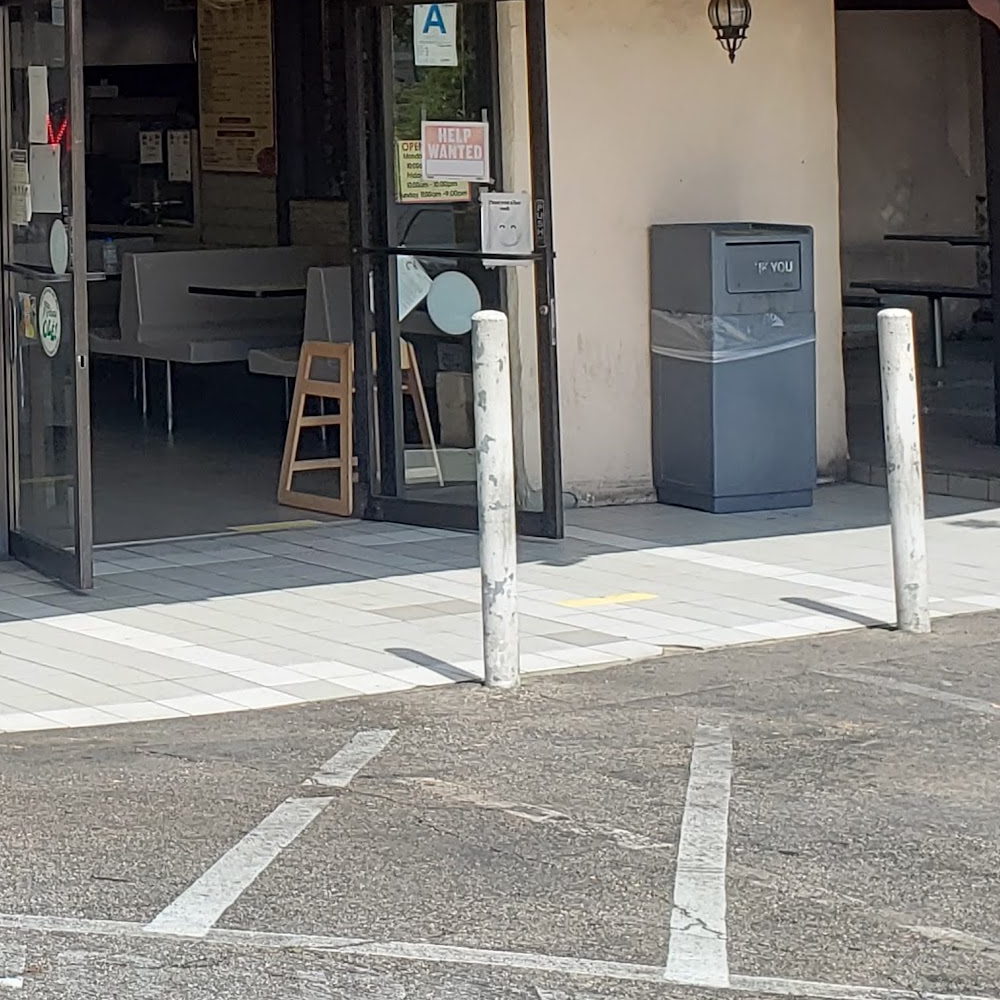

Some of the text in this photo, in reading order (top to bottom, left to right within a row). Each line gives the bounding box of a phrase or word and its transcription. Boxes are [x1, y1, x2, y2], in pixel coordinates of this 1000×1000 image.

[422, 3, 447, 34] A
[438, 127, 471, 143] HELP
[428, 143, 483, 159] WANTED
[770, 260, 793, 273] YOU
